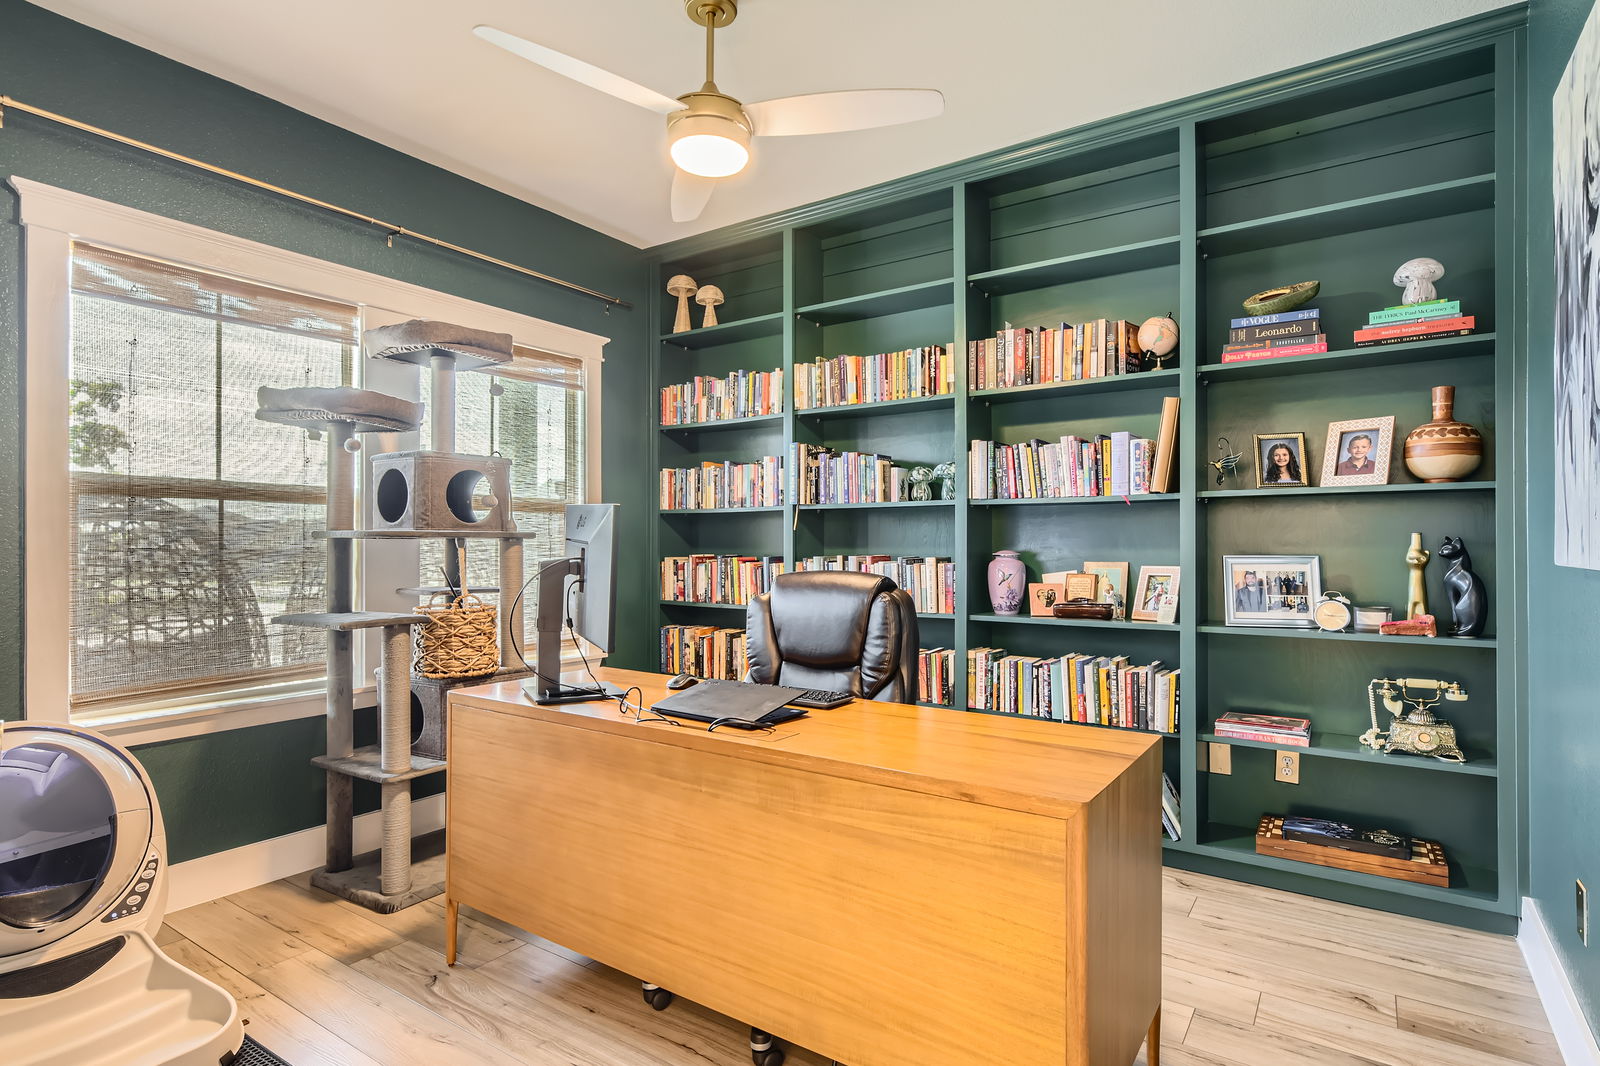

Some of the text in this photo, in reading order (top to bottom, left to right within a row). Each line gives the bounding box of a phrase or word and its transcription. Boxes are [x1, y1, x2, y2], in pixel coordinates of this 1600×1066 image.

[1250, 314, 1279, 325] VOGUE
[1256, 324, 1302, 338] Leonardo
[1225, 351, 1272, 362] DOLLY PARTON
